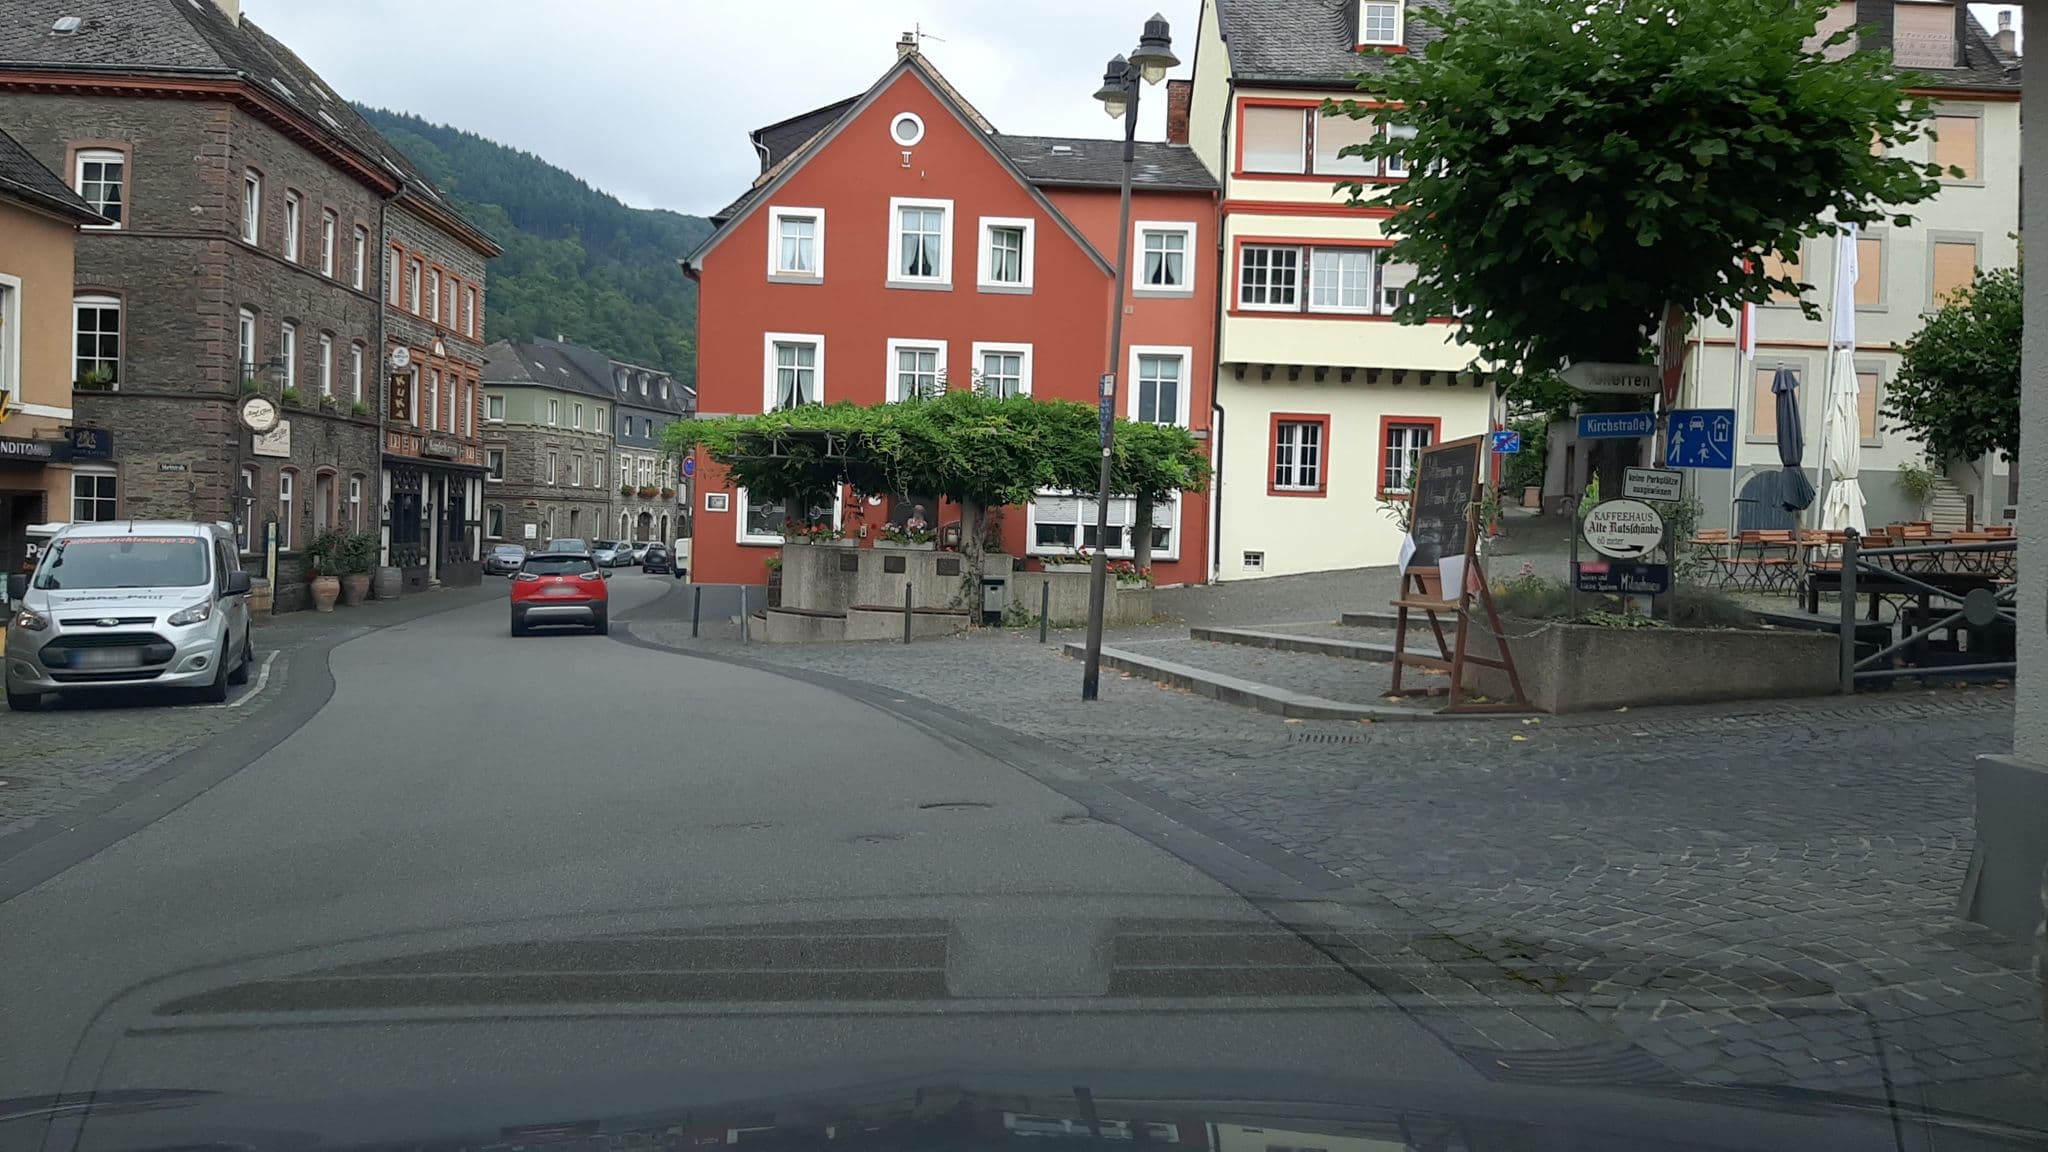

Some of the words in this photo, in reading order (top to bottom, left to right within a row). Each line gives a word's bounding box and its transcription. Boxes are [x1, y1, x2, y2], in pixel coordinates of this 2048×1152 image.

[395, 375, 406, 419] KUKA
[1587, 418, 1645, 433] Kirchstraße
[1594, 511, 1654, 521] KAFFEEHAUS
[1587, 521, 1607, 534] Alte
